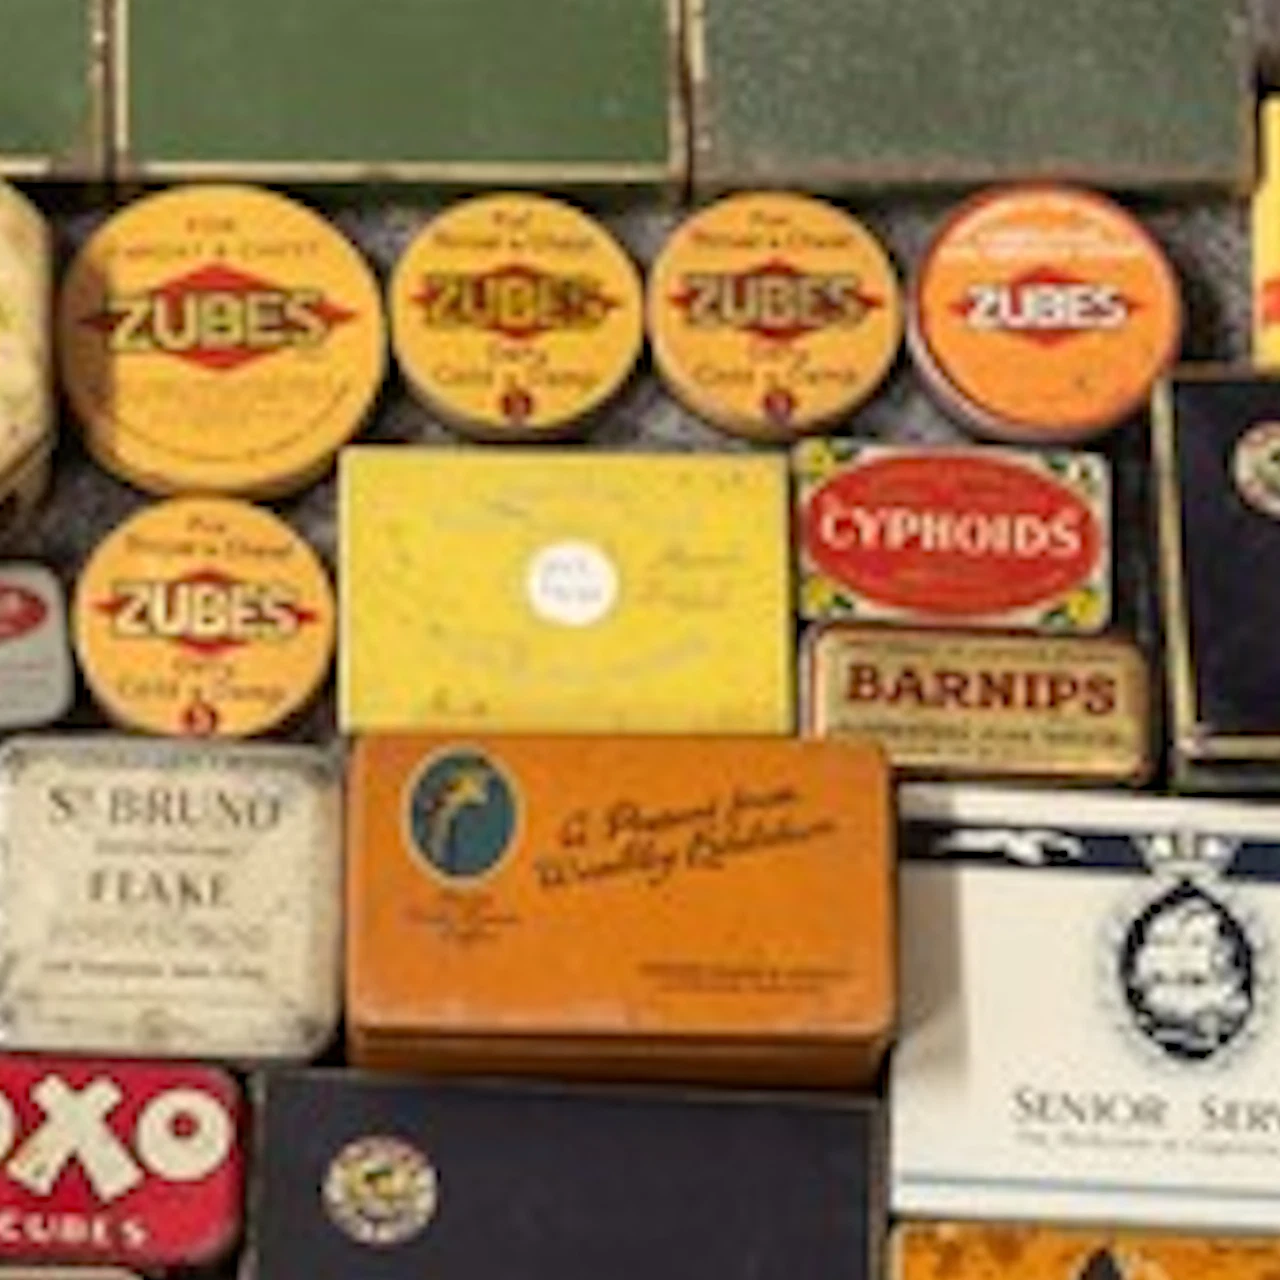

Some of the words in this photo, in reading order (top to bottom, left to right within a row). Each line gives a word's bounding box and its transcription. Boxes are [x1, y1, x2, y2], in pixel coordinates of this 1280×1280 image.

[107, 289, 325, 352] ZUBES
[686, 273, 862, 327] ZUBES
[966, 284, 1128, 331] ZUBES
[821, 498, 1082, 559] CYPHOIDS
[112, 583, 300, 639] ZUBES
[847, 662, 1117, 715] BARNIPS
[110, 787, 281, 830] BRUNO
[89, 870, 231, 908] FLAKE
[1012, 1084, 1169, 1128] SENIOR
